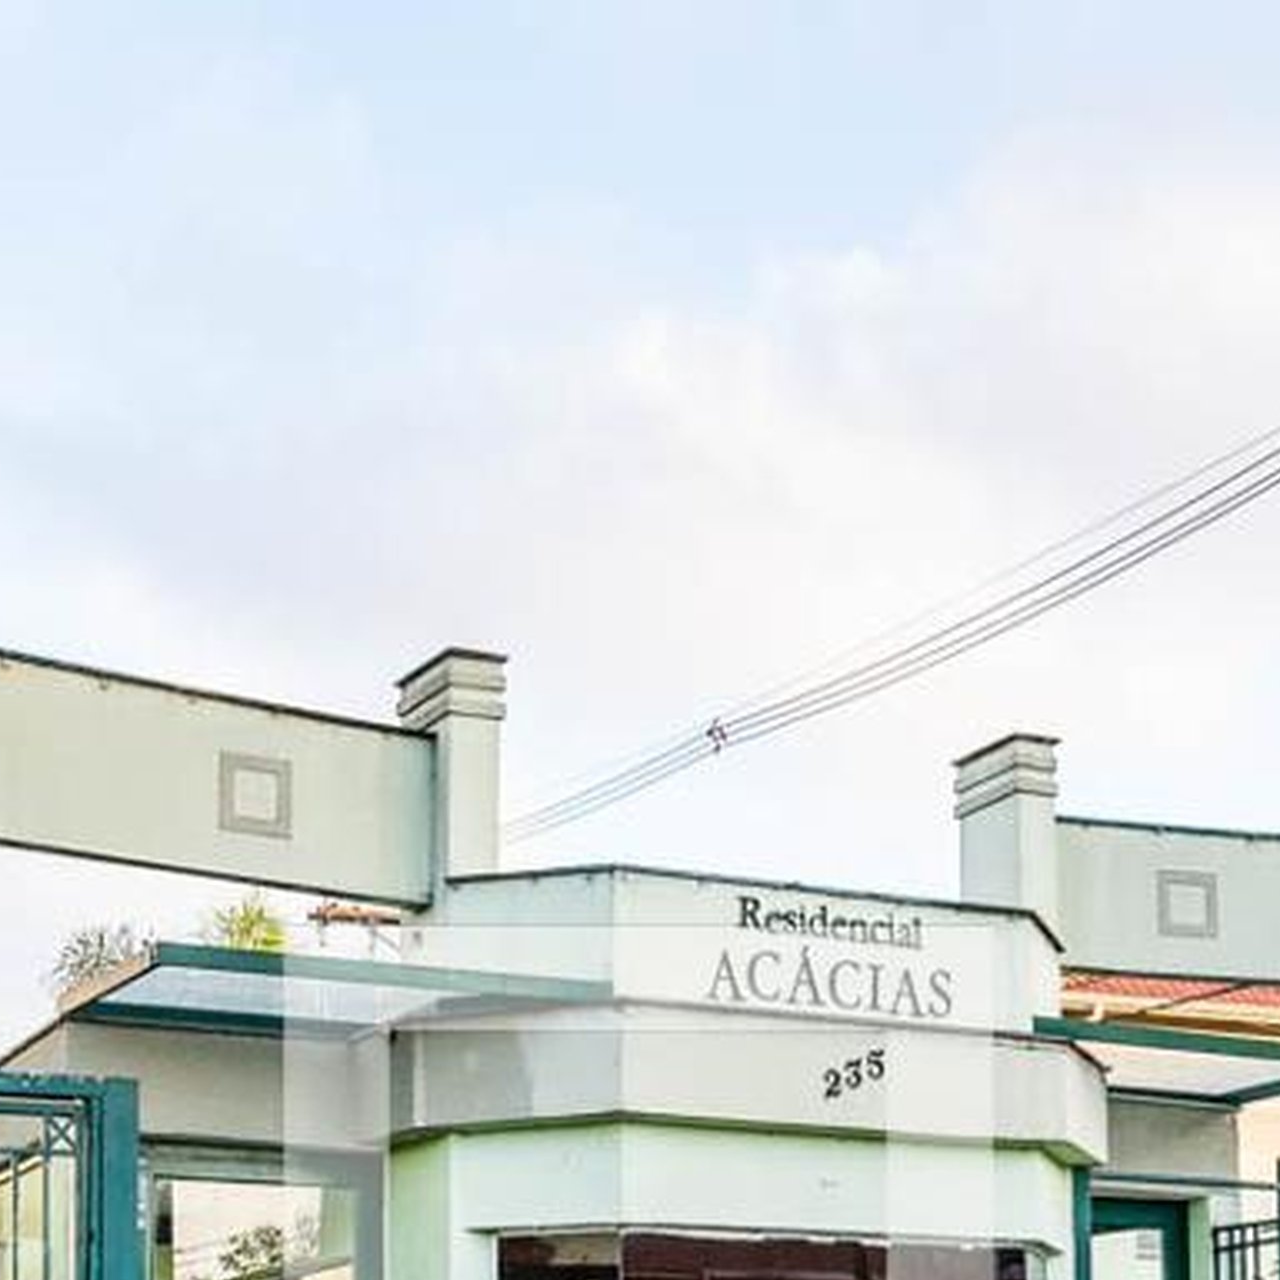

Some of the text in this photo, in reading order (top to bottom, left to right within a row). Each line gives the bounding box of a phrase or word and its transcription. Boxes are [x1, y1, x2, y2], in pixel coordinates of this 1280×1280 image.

[737, 895, 922, 949] Residencial
[707, 945, 952, 1017] ACÁCIAS
[824, 1048, 885, 1098] 235
